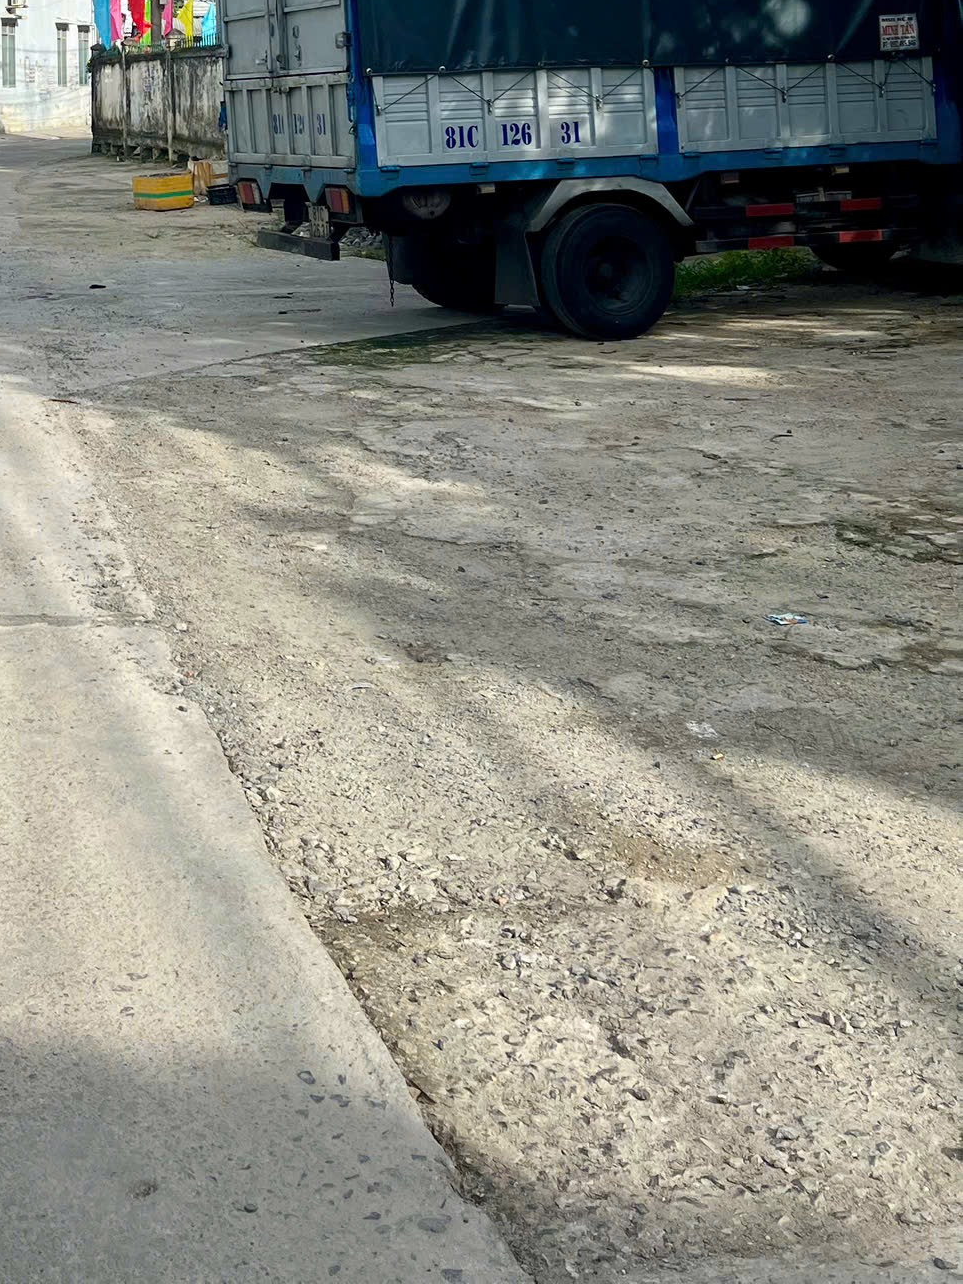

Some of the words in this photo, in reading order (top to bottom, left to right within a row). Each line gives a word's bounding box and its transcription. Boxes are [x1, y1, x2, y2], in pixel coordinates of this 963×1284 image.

[317, 113, 326, 136] 31
[445, 125, 479, 149] 81C
[501, 122, 532, 146] 126
[560, 121, 581, 145] 31
